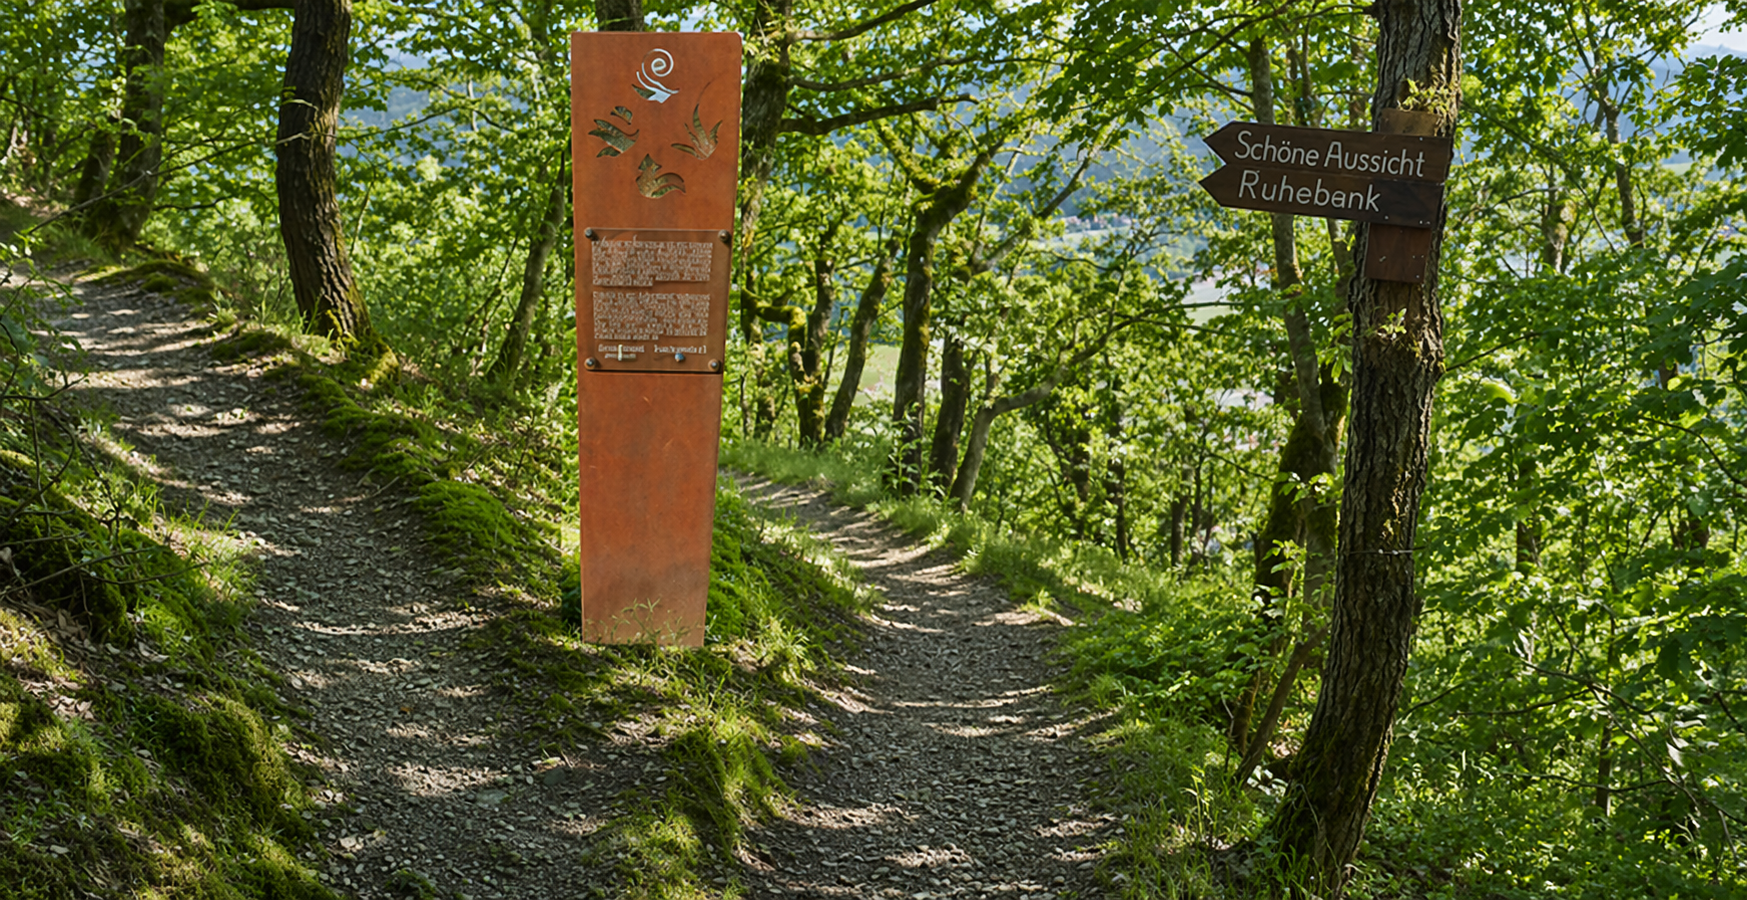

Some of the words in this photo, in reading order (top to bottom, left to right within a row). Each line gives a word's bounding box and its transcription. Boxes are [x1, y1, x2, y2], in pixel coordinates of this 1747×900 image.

[1235, 130, 1320, 167] Schöne
[1324, 141, 1425, 177] Aussicht
[1238, 169, 1381, 212] Ruhebank
